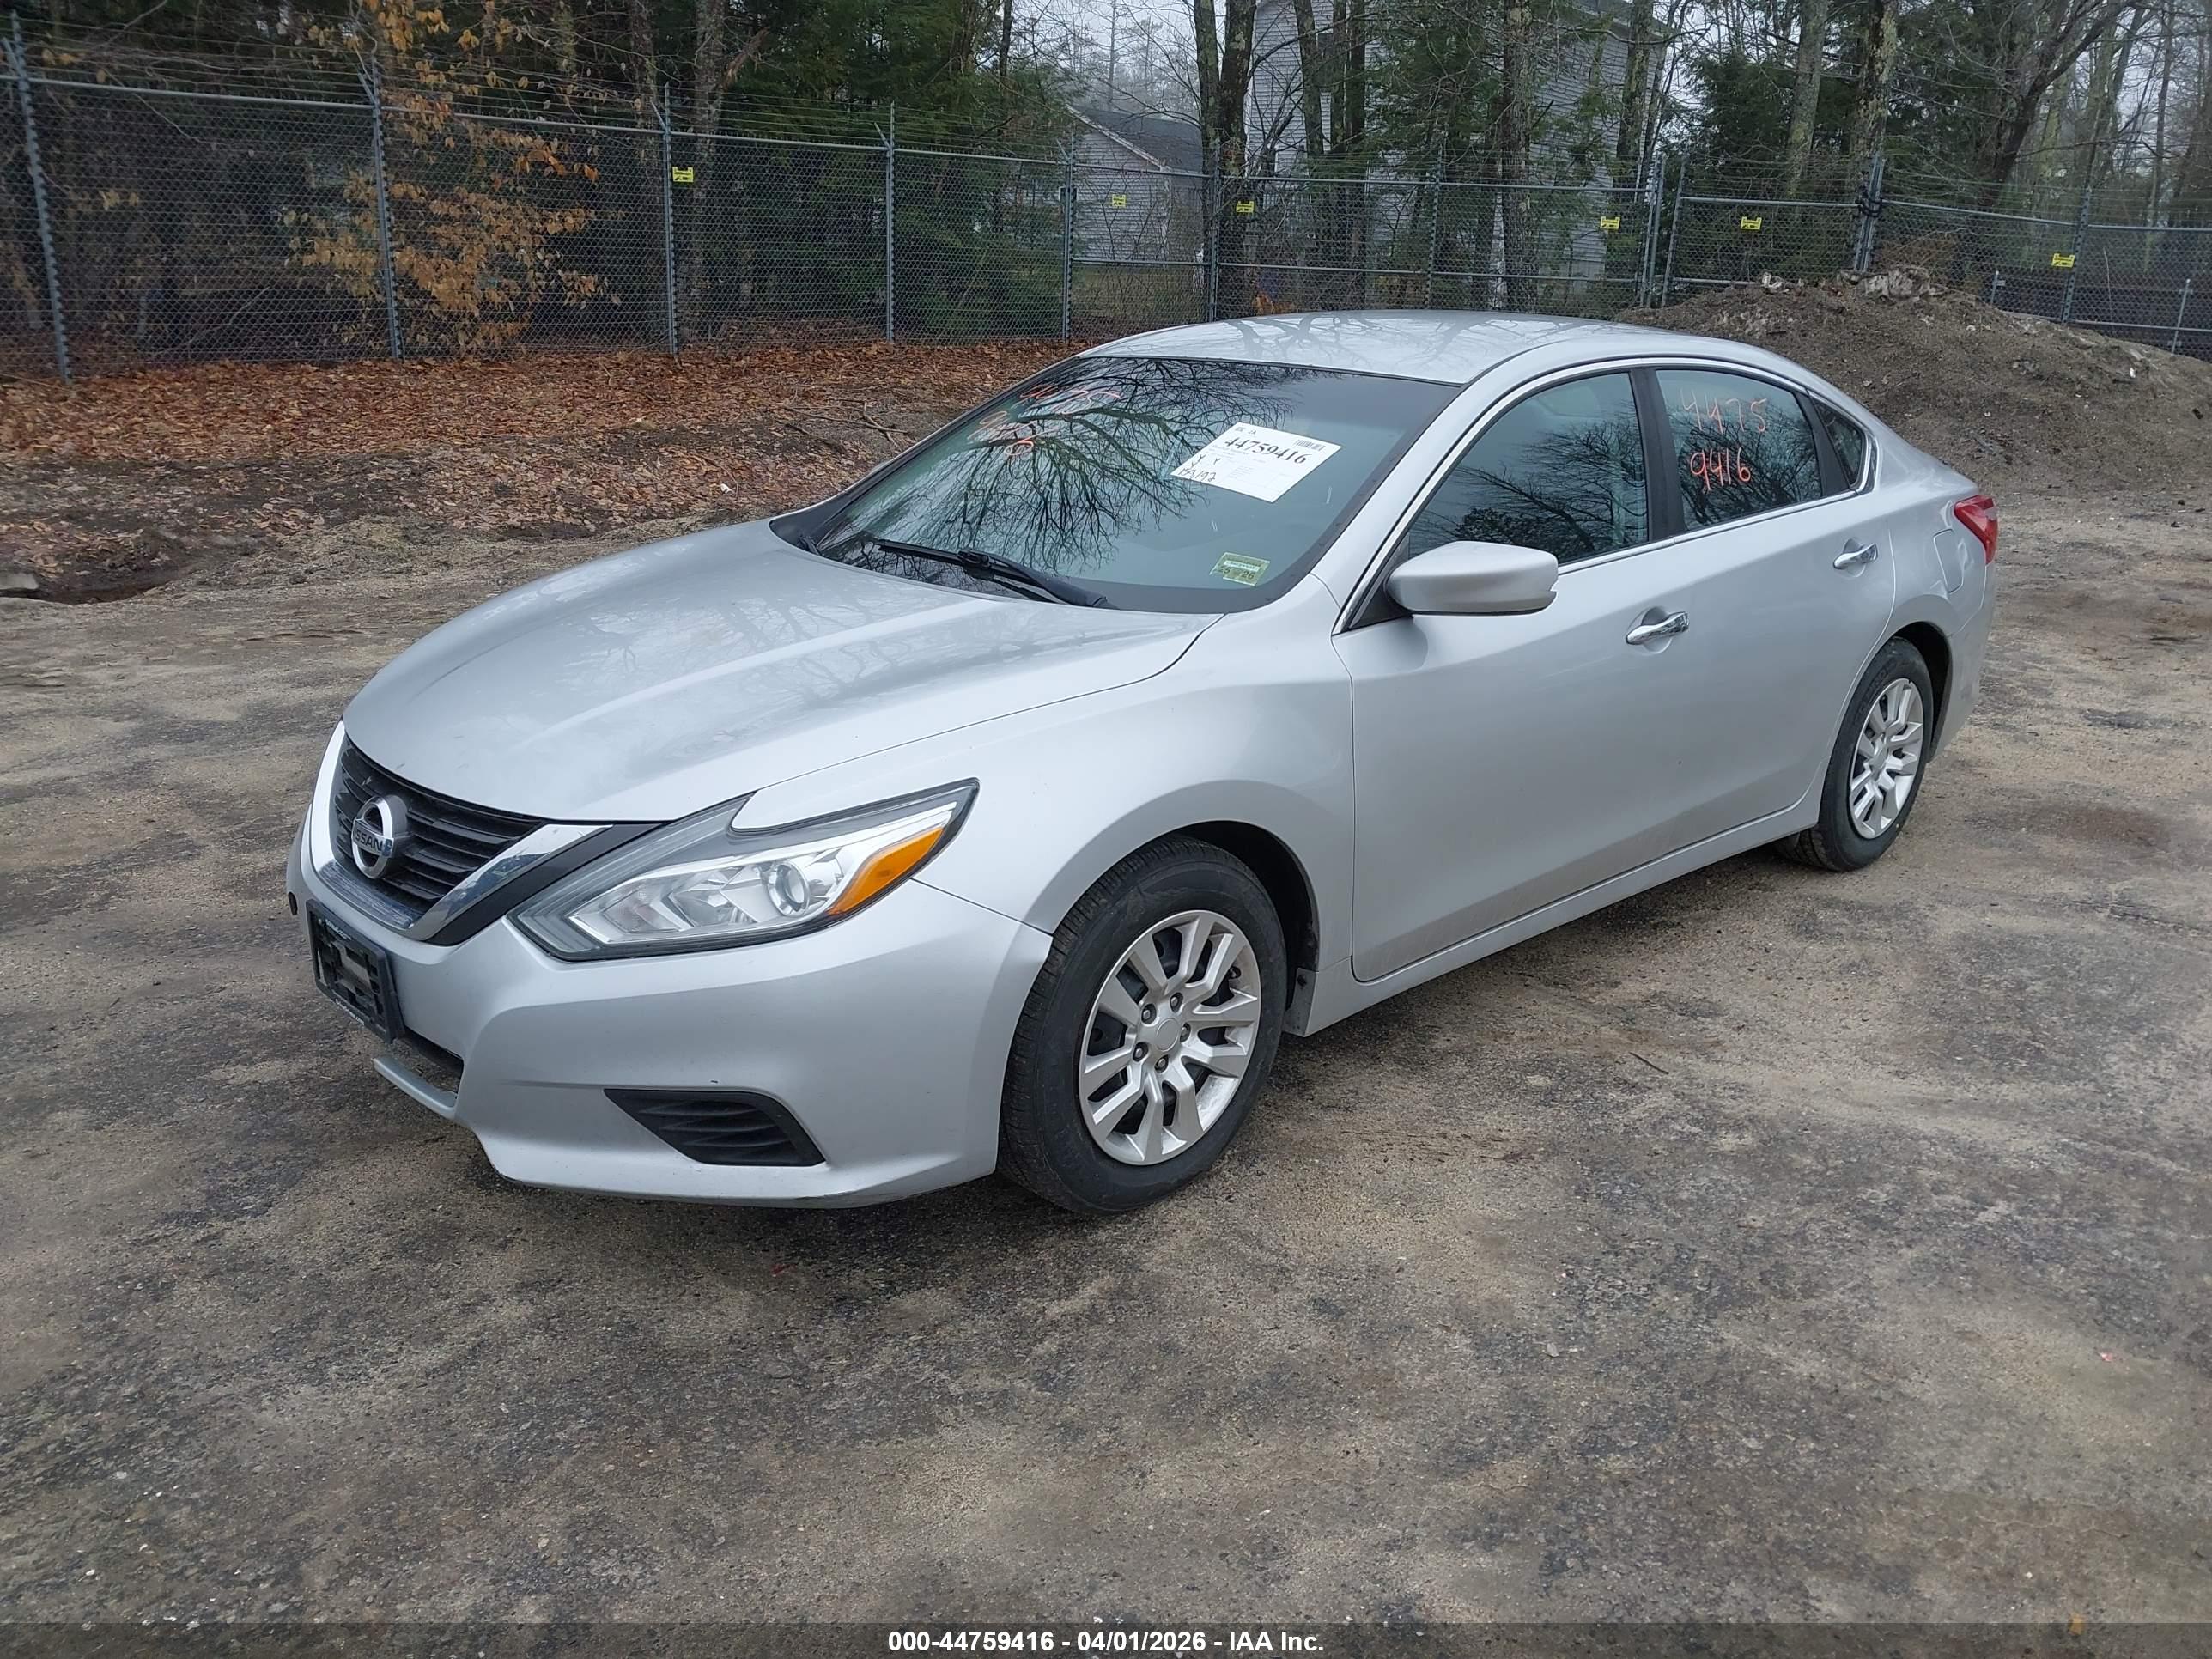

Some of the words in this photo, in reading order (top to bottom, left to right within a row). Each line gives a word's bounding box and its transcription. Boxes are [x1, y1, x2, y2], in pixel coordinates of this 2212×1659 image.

[1680, 388, 1767, 434] 4475
[1224, 436, 1313, 465] 44759416
[1690, 447, 1752, 492] 9416
[352, 827, 384, 852] ISSAN
